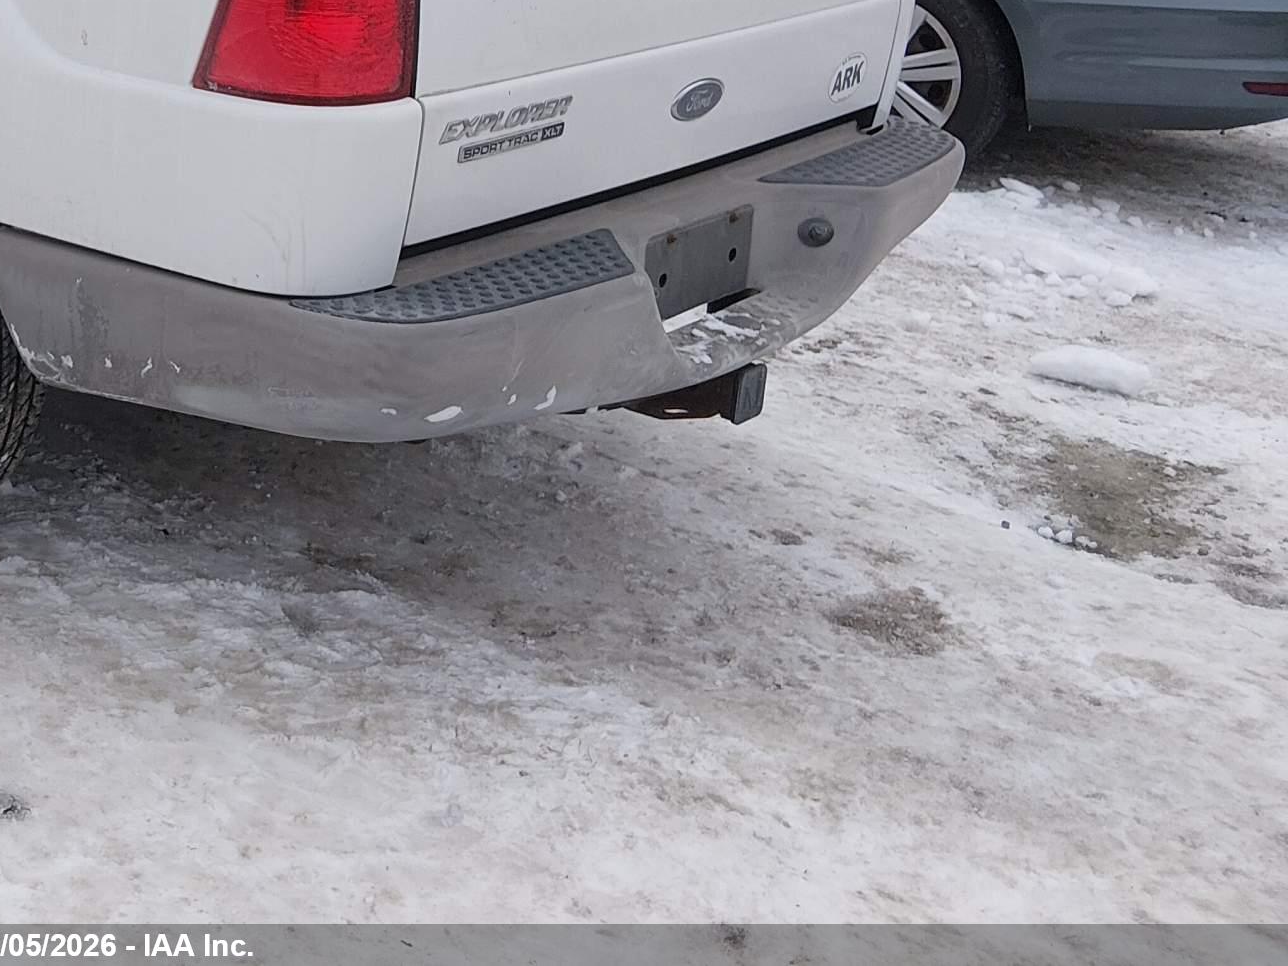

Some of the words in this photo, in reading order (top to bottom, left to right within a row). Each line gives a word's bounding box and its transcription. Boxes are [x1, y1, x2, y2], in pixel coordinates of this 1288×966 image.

[830, 61, 864, 96] ARK
[439, 95, 573, 145] EXPLORER
[463, 140, 505, 160] SPORT
[507, 132, 539, 148] TRAC
[543, 125, 563, 139] XLT
